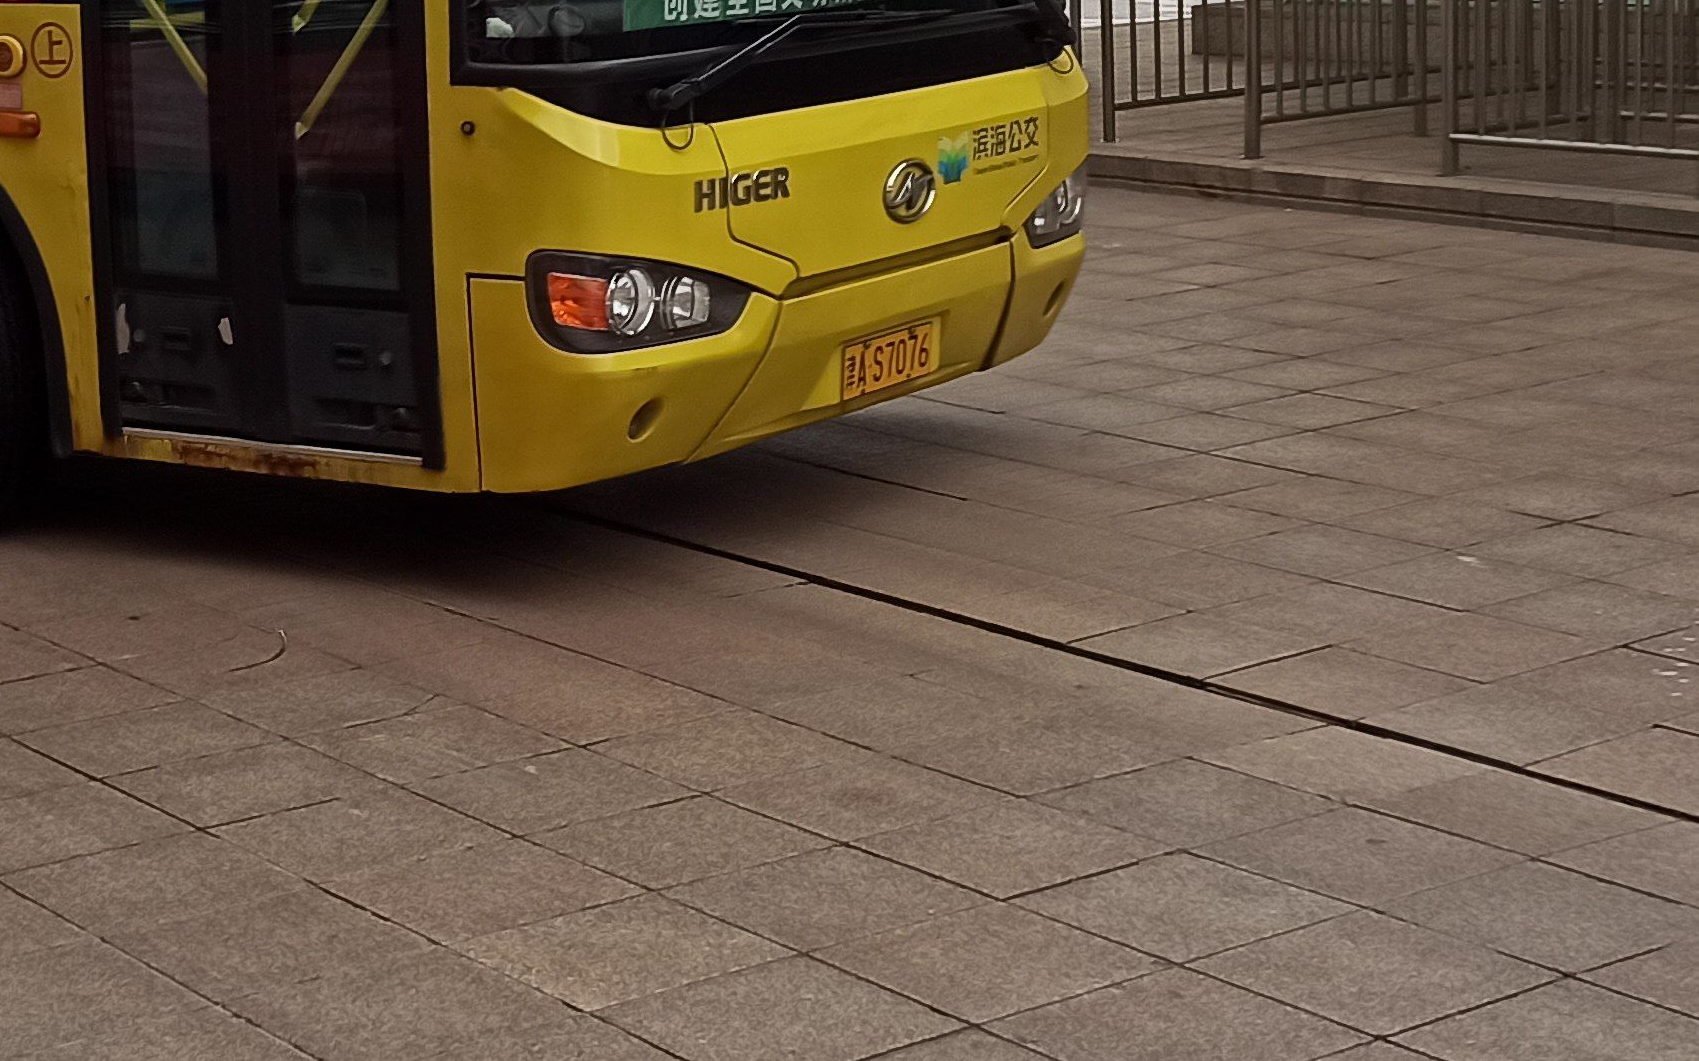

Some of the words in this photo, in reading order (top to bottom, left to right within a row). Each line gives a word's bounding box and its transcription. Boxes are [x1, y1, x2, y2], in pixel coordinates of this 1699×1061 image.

[972, 116, 1039, 161] 滨海公交
[693, 165, 790, 213] HIGER
